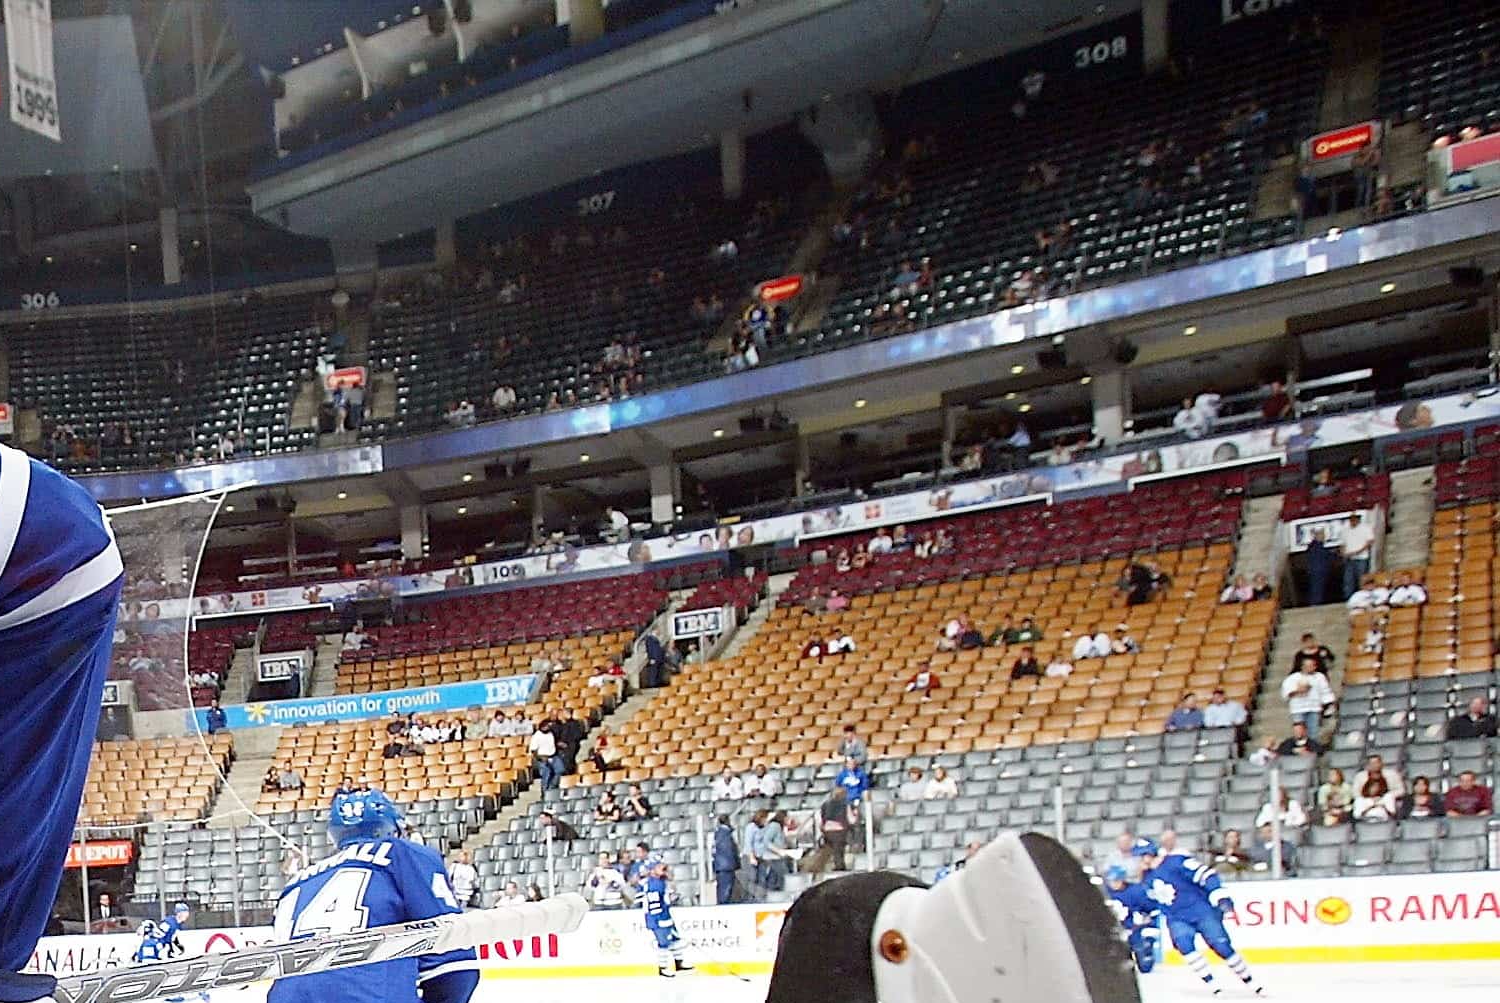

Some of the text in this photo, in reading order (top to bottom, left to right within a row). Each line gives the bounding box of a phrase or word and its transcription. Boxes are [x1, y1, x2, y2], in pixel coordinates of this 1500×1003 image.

[1075, 36, 1127, 67] 308
[17, 83, 56, 127] 1999
[21, 291, 60, 310] 306
[274, 676, 533, 720] innovation for growth IBM
[1370, 892, 1500, 921] RAMA
